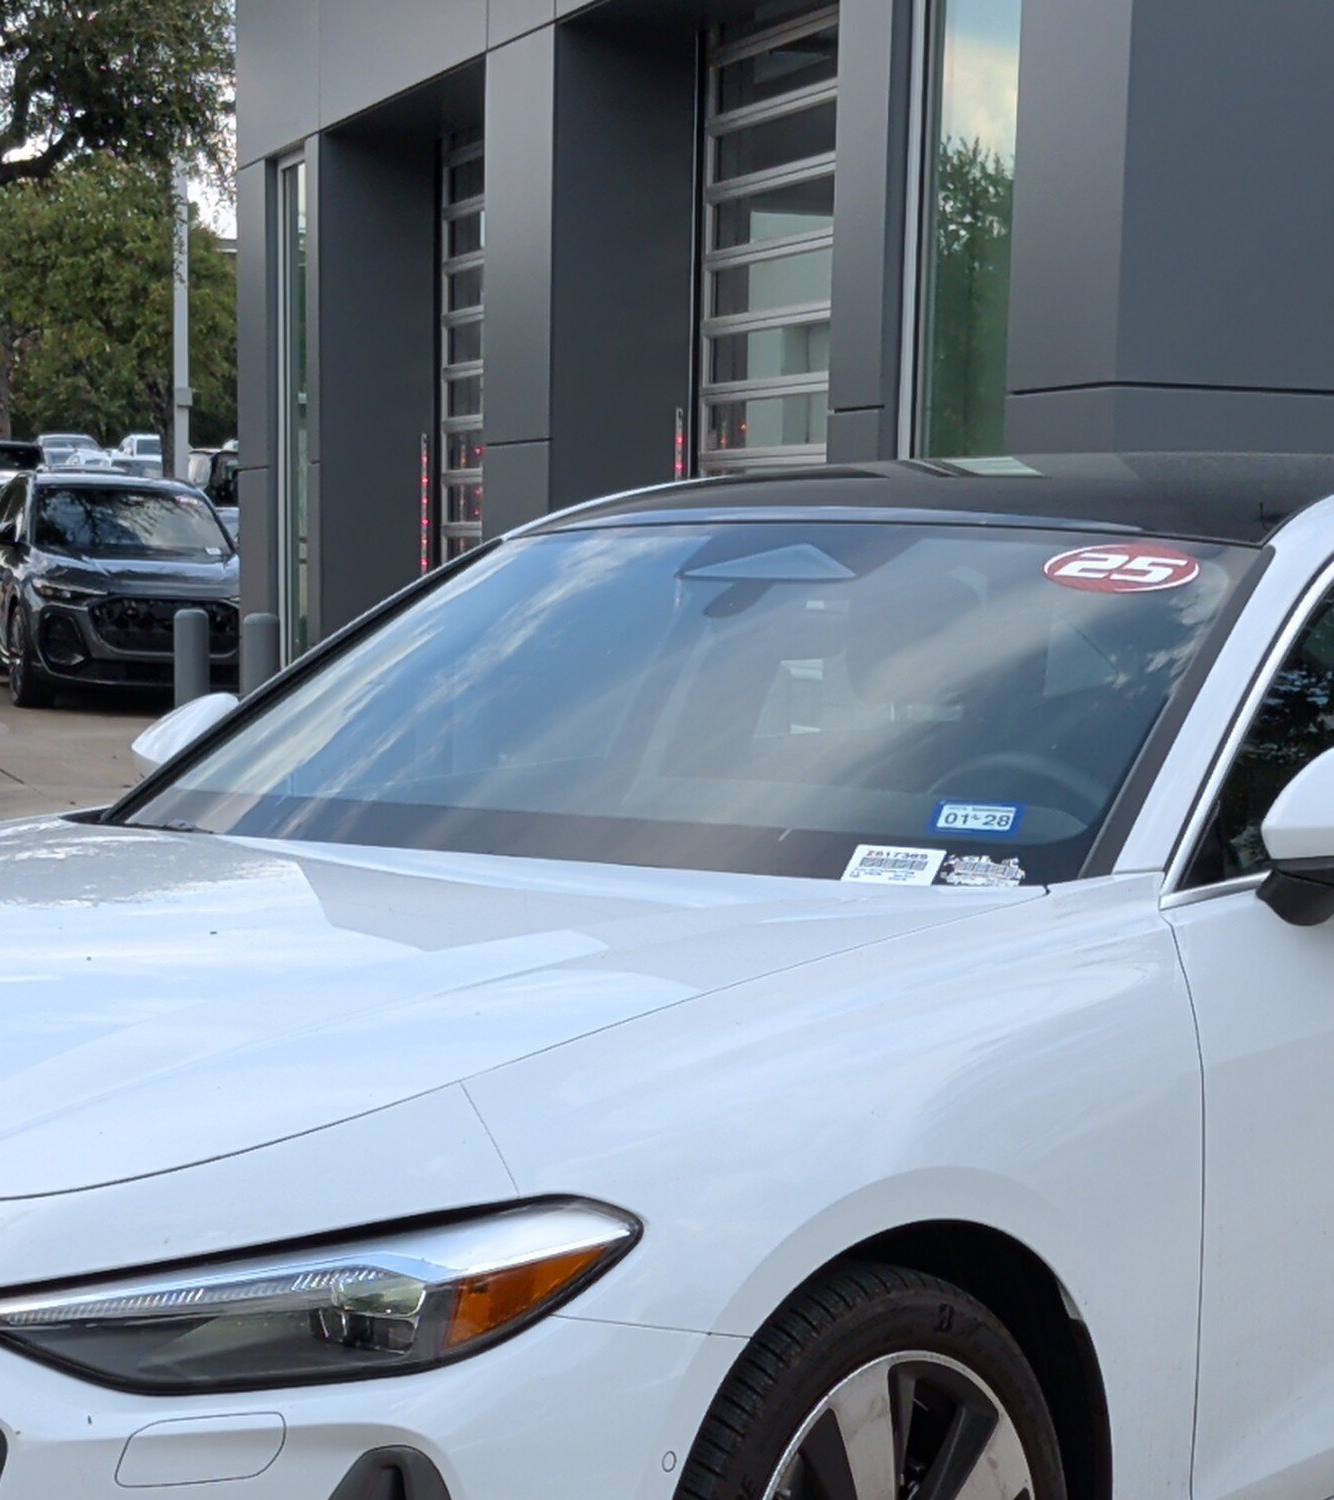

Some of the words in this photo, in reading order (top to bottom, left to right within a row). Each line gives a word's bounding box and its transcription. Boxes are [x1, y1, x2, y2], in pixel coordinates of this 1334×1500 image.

[1053, 551, 1188, 584] 25
[944, 812, 969, 826] 01
[982, 814, 1011, 828] 28
